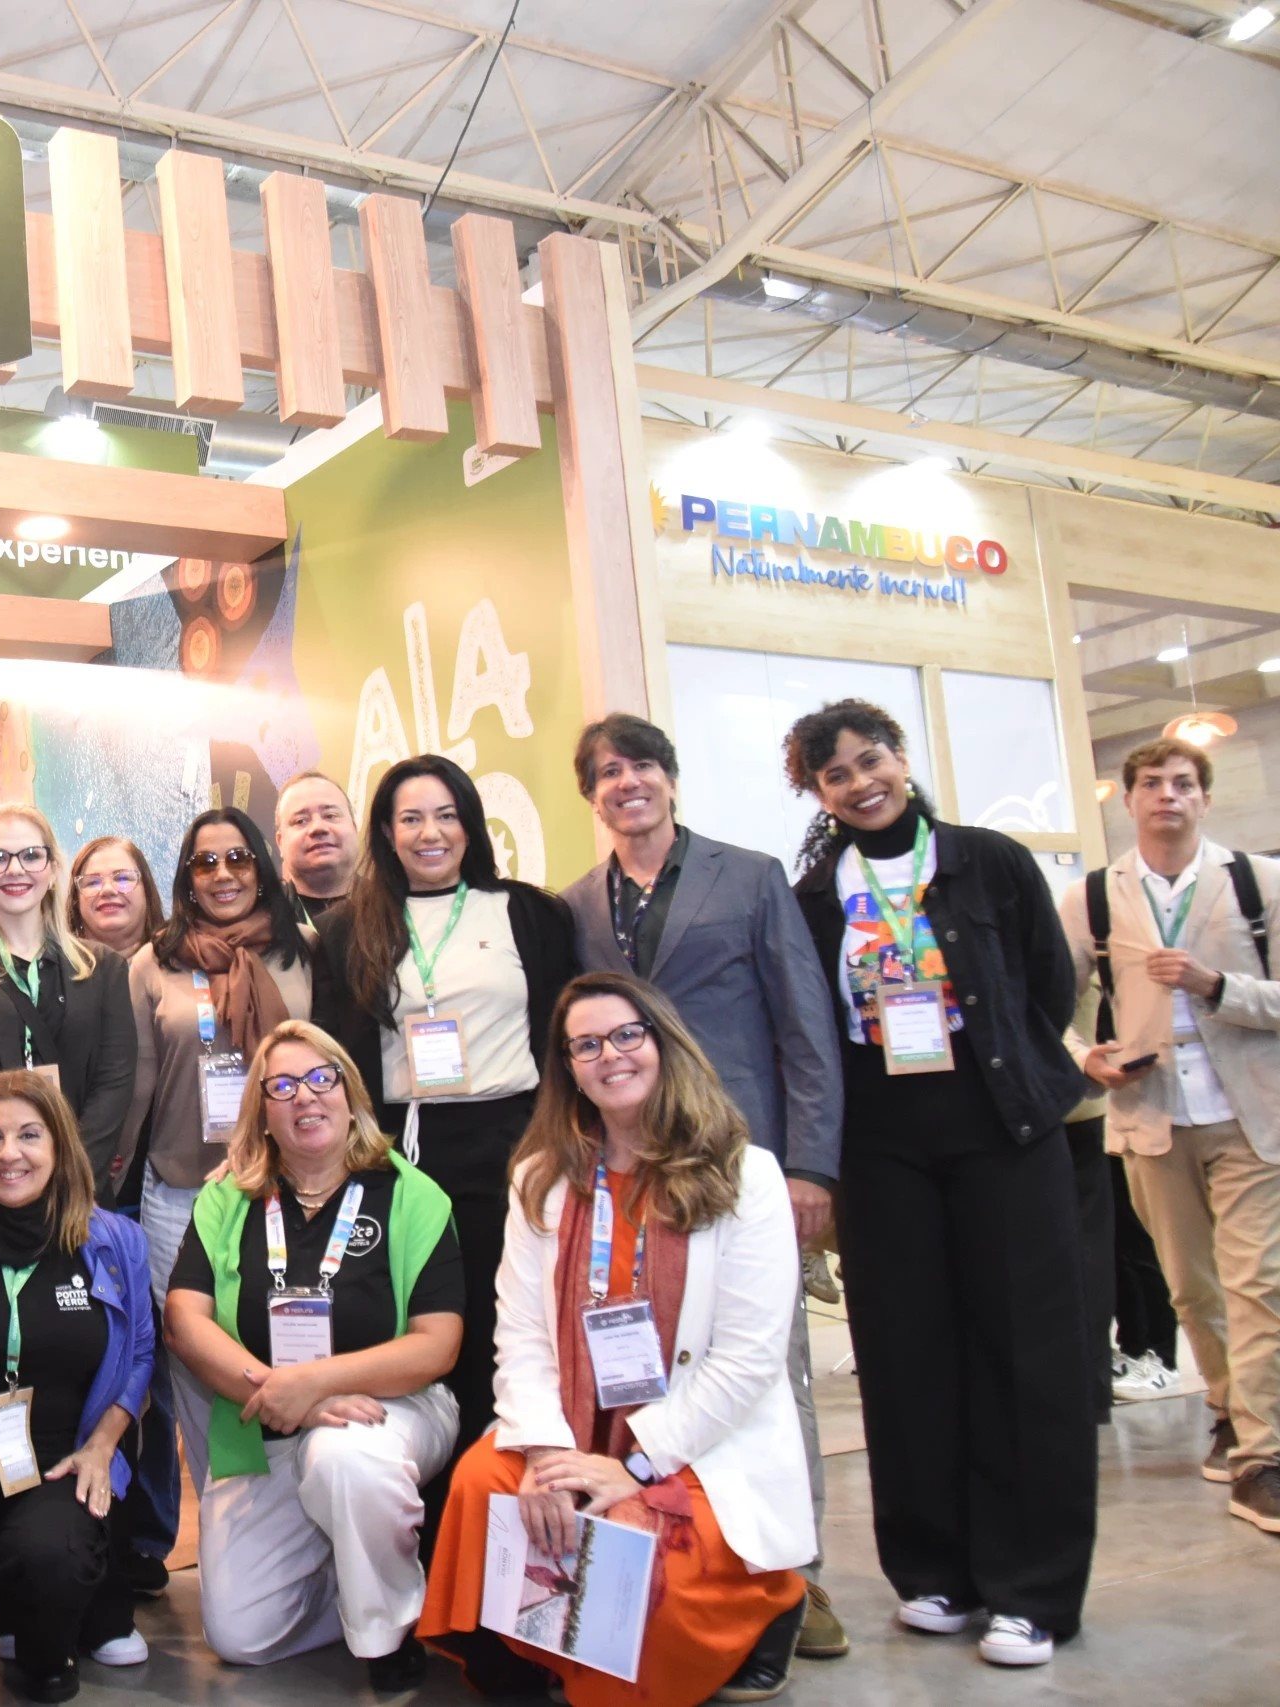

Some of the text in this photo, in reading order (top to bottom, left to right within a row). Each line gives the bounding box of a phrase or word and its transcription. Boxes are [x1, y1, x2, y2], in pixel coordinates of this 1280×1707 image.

[681, 494, 1008, 575] PERNAMBUCO
[711, 543, 874, 592] Naturalmente
[56, 1290, 88, 1299] PONTA
[56, 1298, 89, 1307] VERDE
